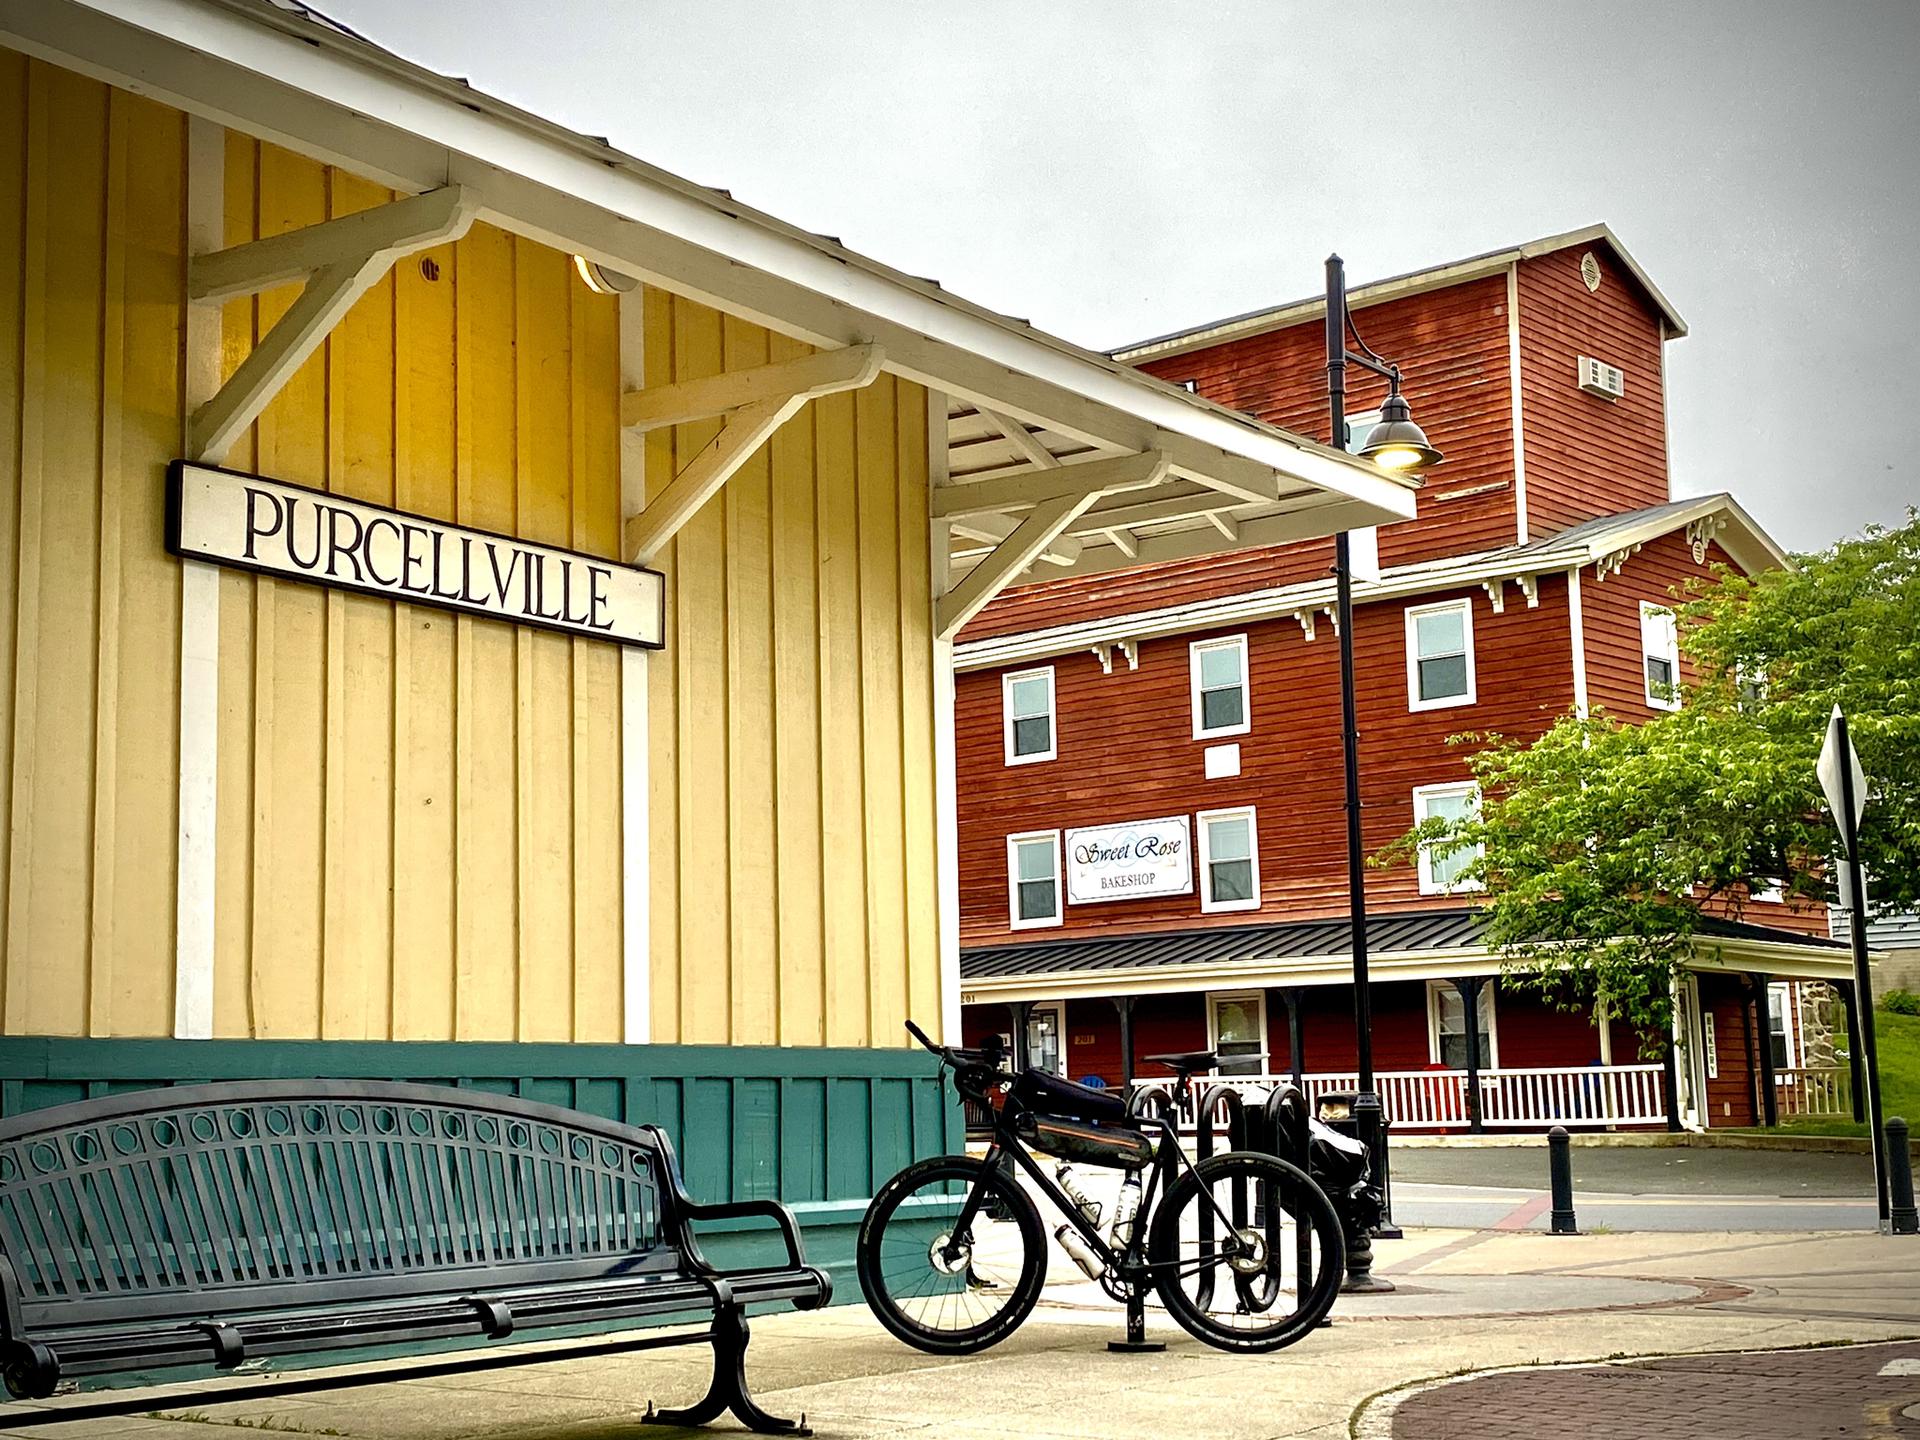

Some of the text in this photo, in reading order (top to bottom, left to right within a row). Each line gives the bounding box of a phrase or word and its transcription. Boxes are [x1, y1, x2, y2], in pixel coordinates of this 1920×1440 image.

[242, 486, 615, 631] PURCELLVILLE
[1075, 836, 1181, 864] Sweet Rose
[1100, 872, 1156, 889] BAKESHOP
[1706, 1016, 1715, 1074] BAKERY
